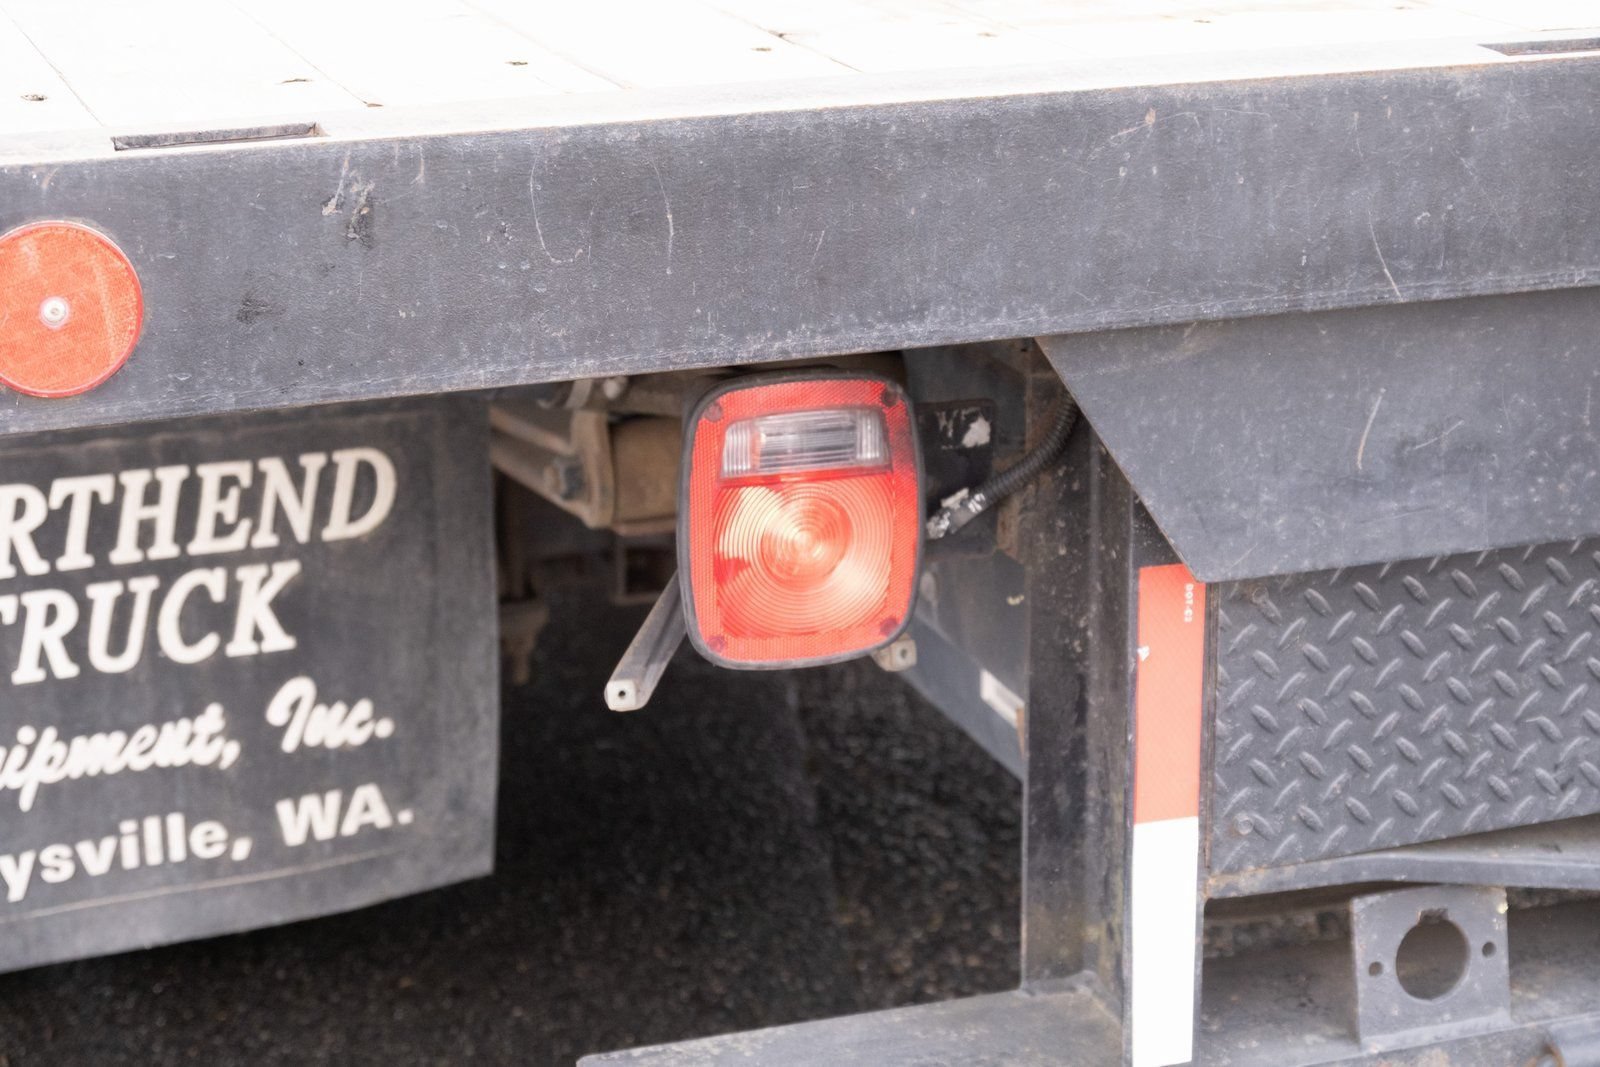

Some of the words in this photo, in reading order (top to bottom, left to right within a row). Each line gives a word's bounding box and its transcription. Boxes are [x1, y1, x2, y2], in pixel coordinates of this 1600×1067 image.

[0, 447, 397, 580] RTHEND
[1184, 583, 1194, 623] DOT-C2
[265, 676, 395, 754] Inc.
[0, 812, 253, 902] ysville,
[275, 783, 414, 847] WA.
